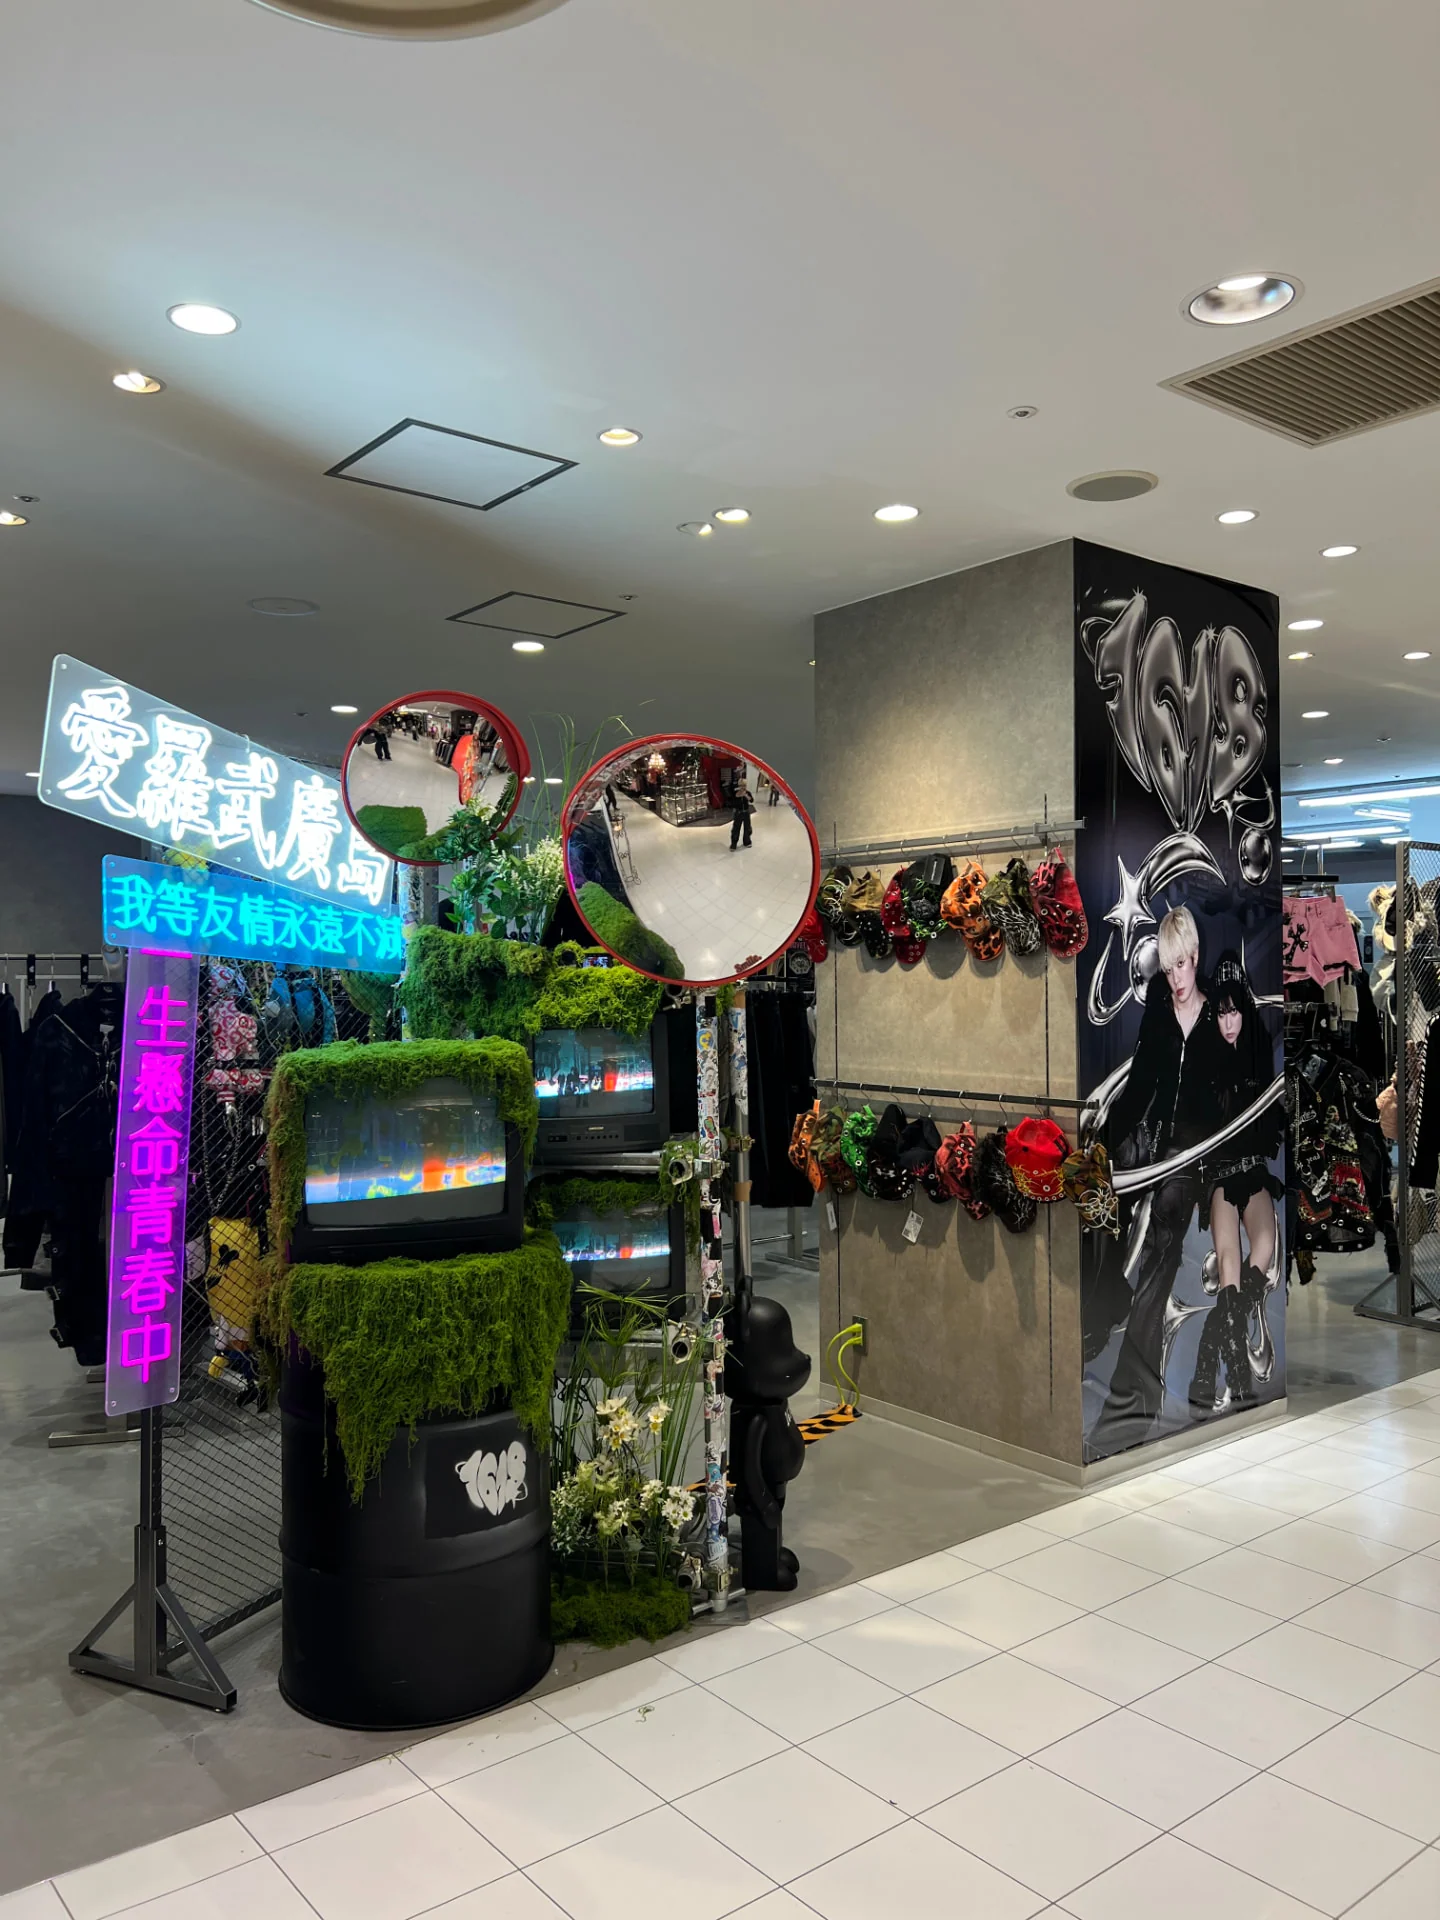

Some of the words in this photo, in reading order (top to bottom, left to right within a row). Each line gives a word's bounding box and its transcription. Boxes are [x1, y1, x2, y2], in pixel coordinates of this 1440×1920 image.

[119, 947, 194, 1384] 一生懸命青春中
